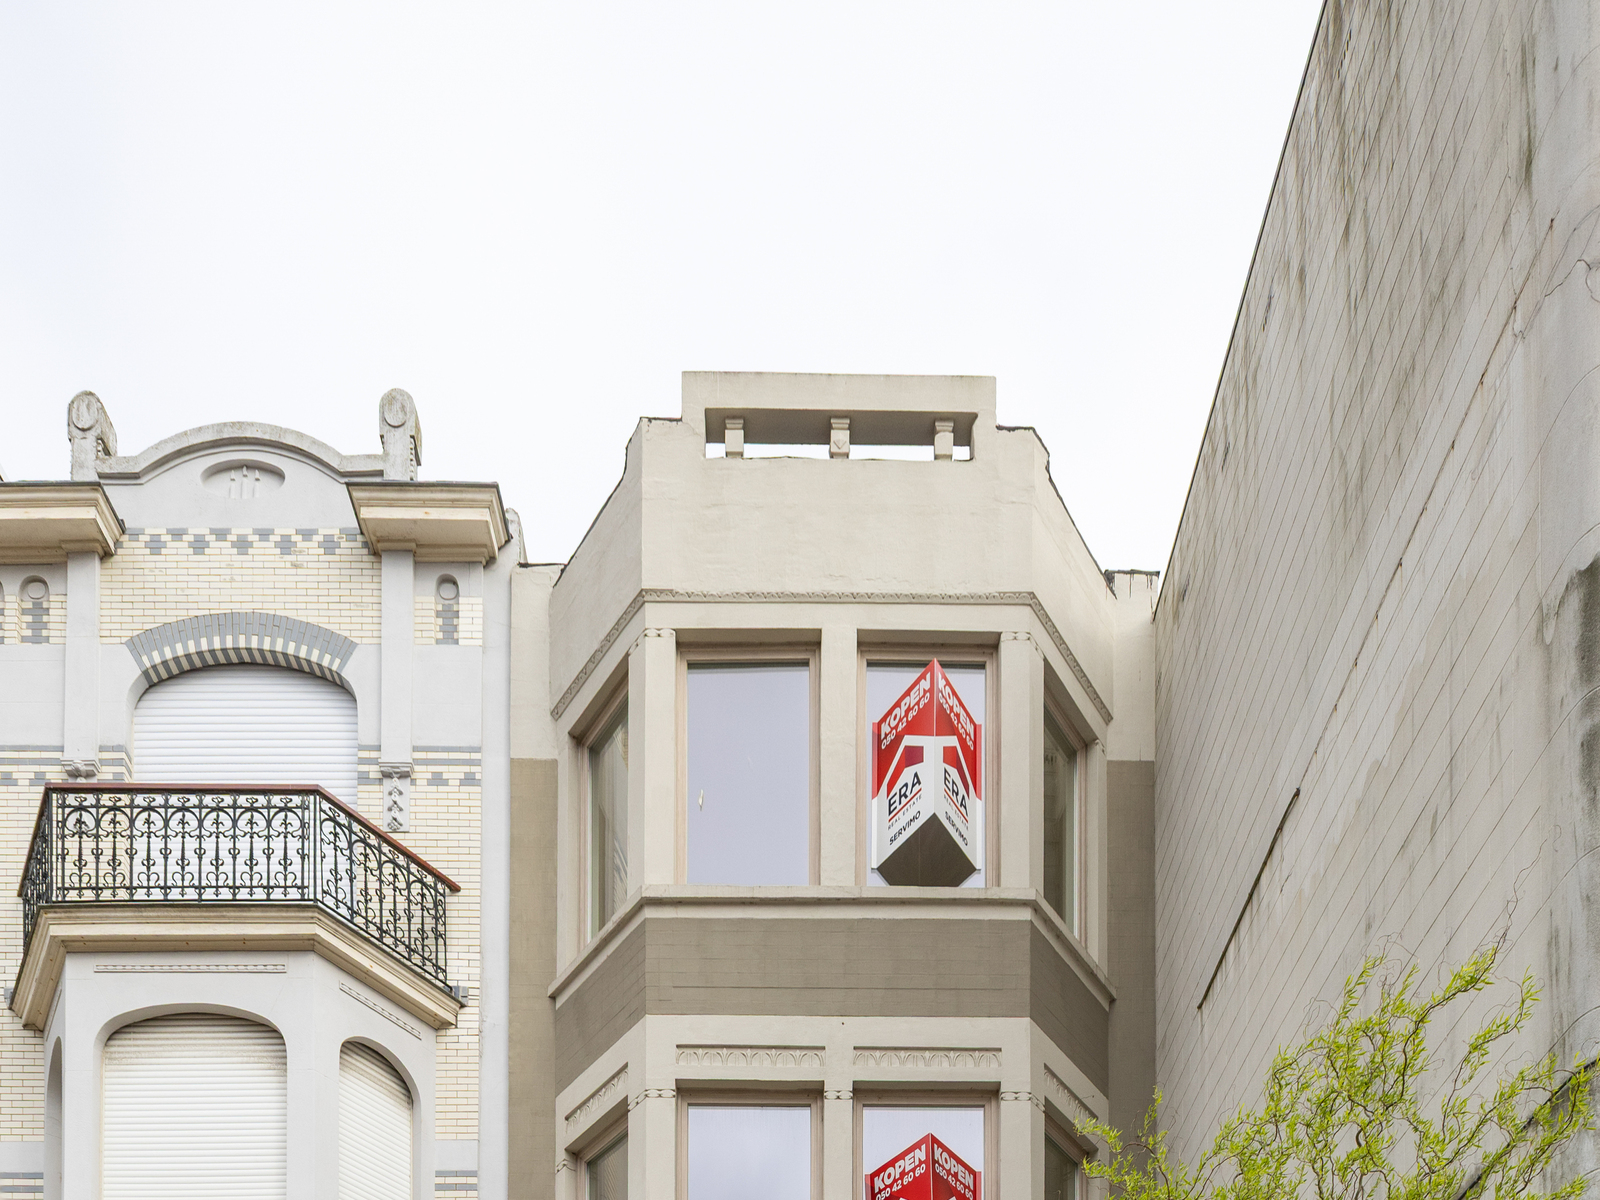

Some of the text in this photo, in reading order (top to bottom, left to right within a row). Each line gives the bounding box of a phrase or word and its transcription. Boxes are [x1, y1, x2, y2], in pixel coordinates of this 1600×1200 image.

[881, 672, 930, 740] KOPEN
[881, 692, 930, 750] 050 42 60 60
[939, 672, 974, 741] KOPEN
[888, 771, 922, 817] ERA
[888, 793, 922, 831] REAL ESTATE
[943, 767, 969, 817] ERA
[889, 810, 921, 846] SERVIMO
[945, 811, 968, 846] SERVIMO
[874, 1143, 926, 1193] KOPEN
[892, 1179, 902, 1193] 42
[903, 1172, 914, 1185] 60
[915, 1164, 926, 1177] 60
[934, 1143, 974, 1191] KOPEN
[935, 1164, 974, 1200] 050 42 60 60
